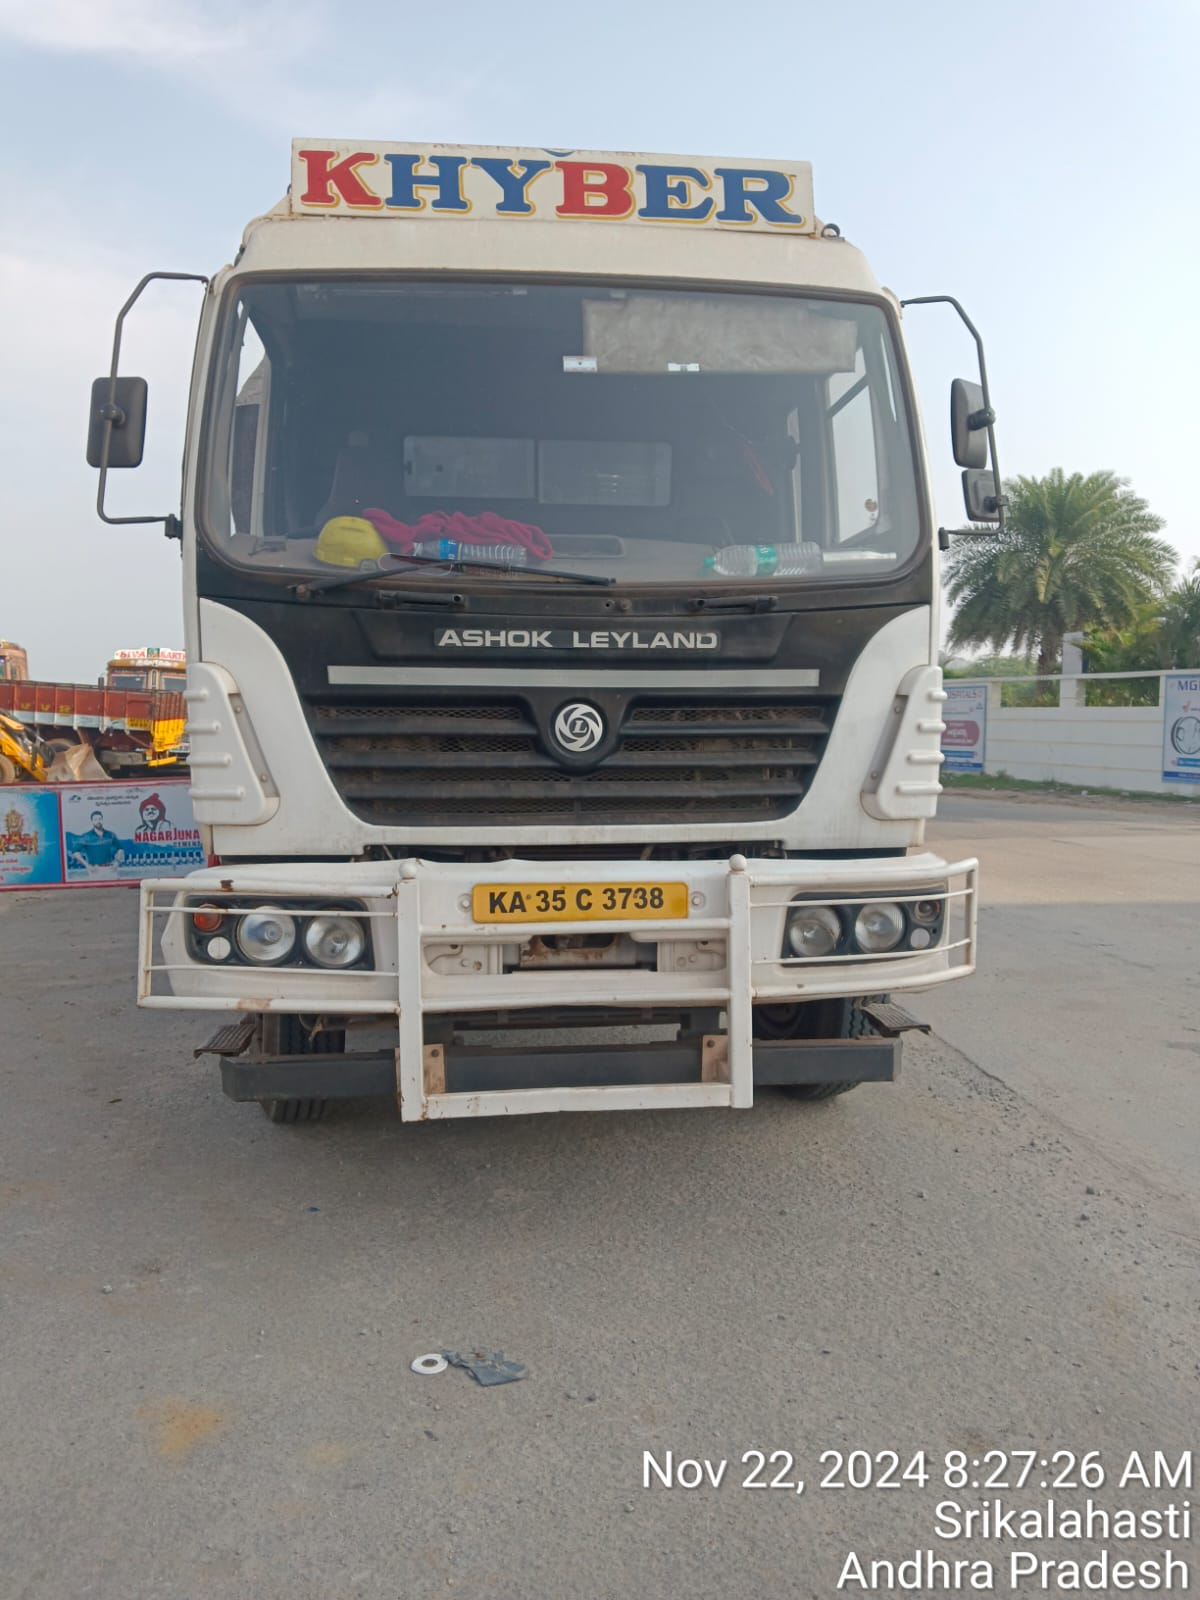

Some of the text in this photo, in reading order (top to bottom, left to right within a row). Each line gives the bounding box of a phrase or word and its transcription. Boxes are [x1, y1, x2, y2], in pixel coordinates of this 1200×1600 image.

[299, 149, 806, 226] KHYBER
[438, 630, 718, 649] ASHOK LEYLAND
[572, 720, 587, 734] L
[134, 827, 200, 842] NAGARJUNA
[489, 887, 664, 914] KA 35 C 3738
